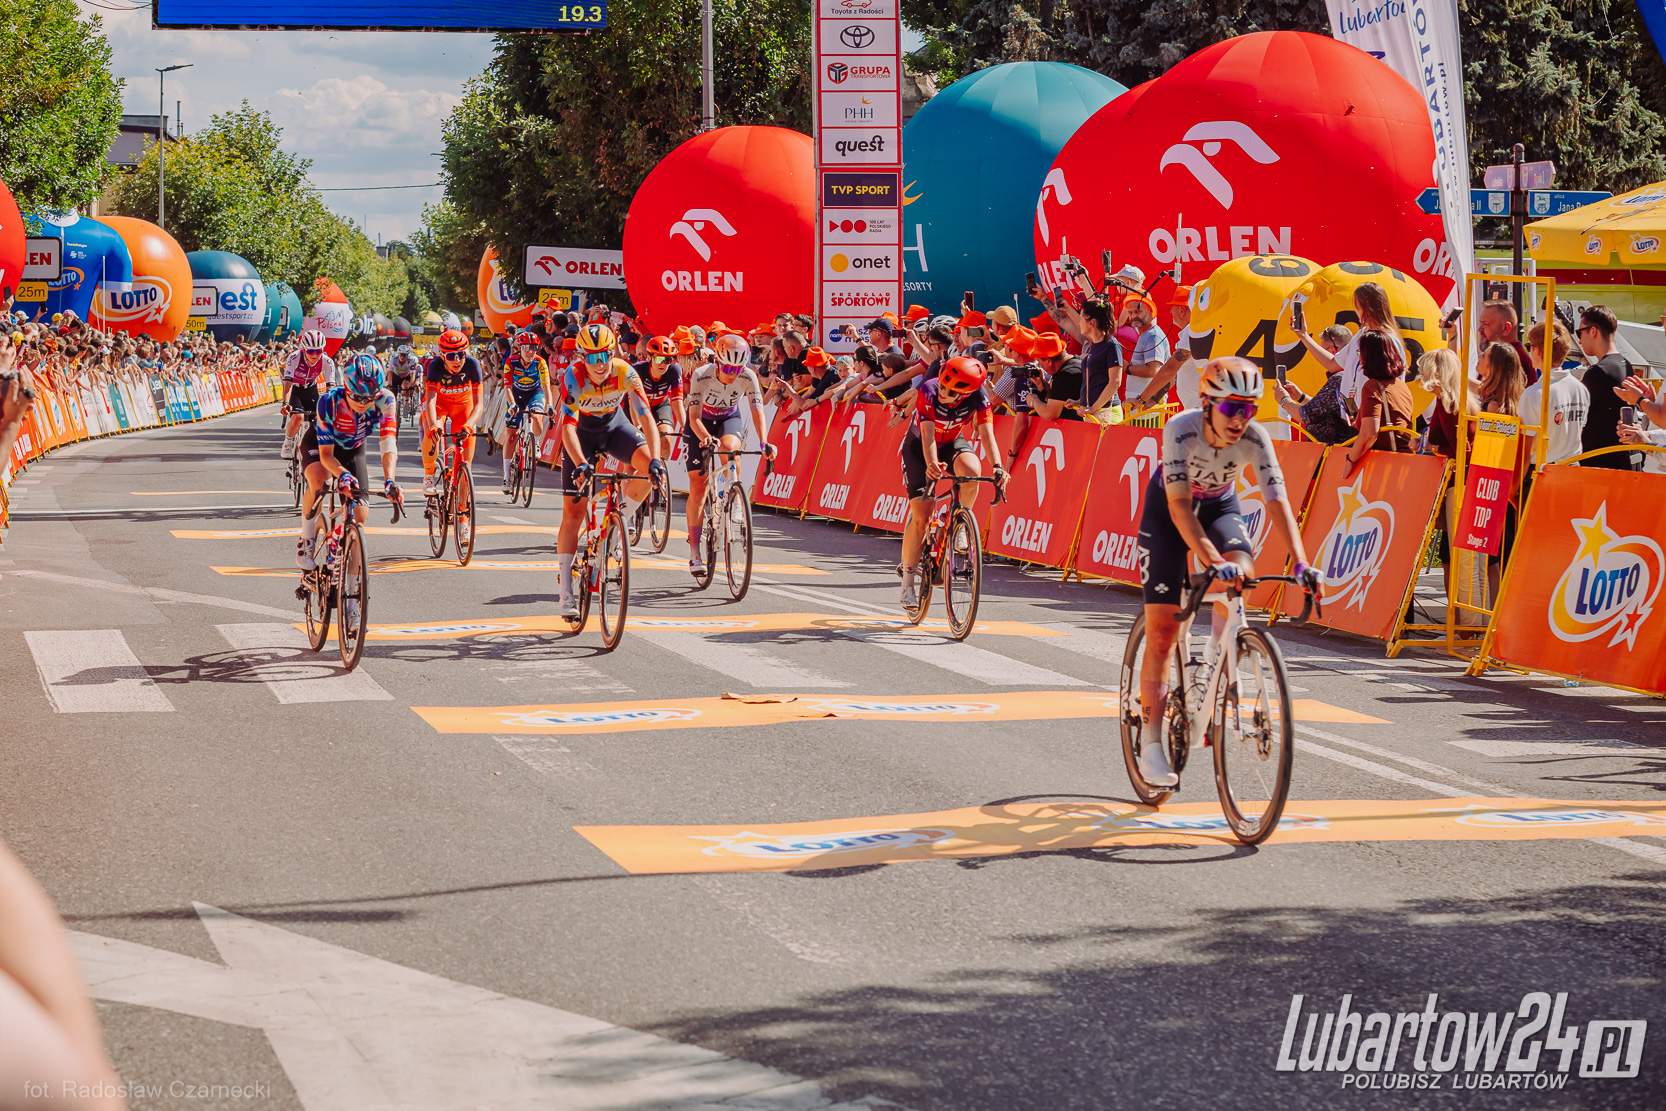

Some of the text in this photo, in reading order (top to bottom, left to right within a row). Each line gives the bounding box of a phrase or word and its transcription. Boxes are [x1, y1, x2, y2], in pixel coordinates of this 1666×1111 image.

[558, 5, 602, 23] 19.3
[850, 66, 890, 75] GRUPA
[844, 107, 873, 119] PHH
[835, 134, 884, 157] quest
[831, 185, 890, 195] TVP SPORT
[1148, 225, 1292, 264] ORLEN
[565, 260, 623, 276] ORLEN
[852, 255, 891, 269] onet
[18, 286, 45, 298] 25m
[661, 269, 744, 292] ORLEN
[110, 287, 157, 310] LOTTO
[830, 297, 890, 307] SPORTOWY
[763, 472, 797, 499] ORLEN
[819, 482, 851, 510] ORLEN
[1476, 477, 1500, 501] CLUB
[872, 493, 910, 524] ORLEN
[1473, 506, 1492, 529] TDP
[1001, 515, 1053, 554] ORLEN
[1467, 533, 1488, 549] Stage 2
[1092, 530, 1140, 571] ORLEN
[1326, 526, 1378, 579] LOTTO
[1574, 562, 1641, 616] LOTTO
[545, 710, 659, 724] LOTTO
[756, 833, 900, 853] LOTTO
